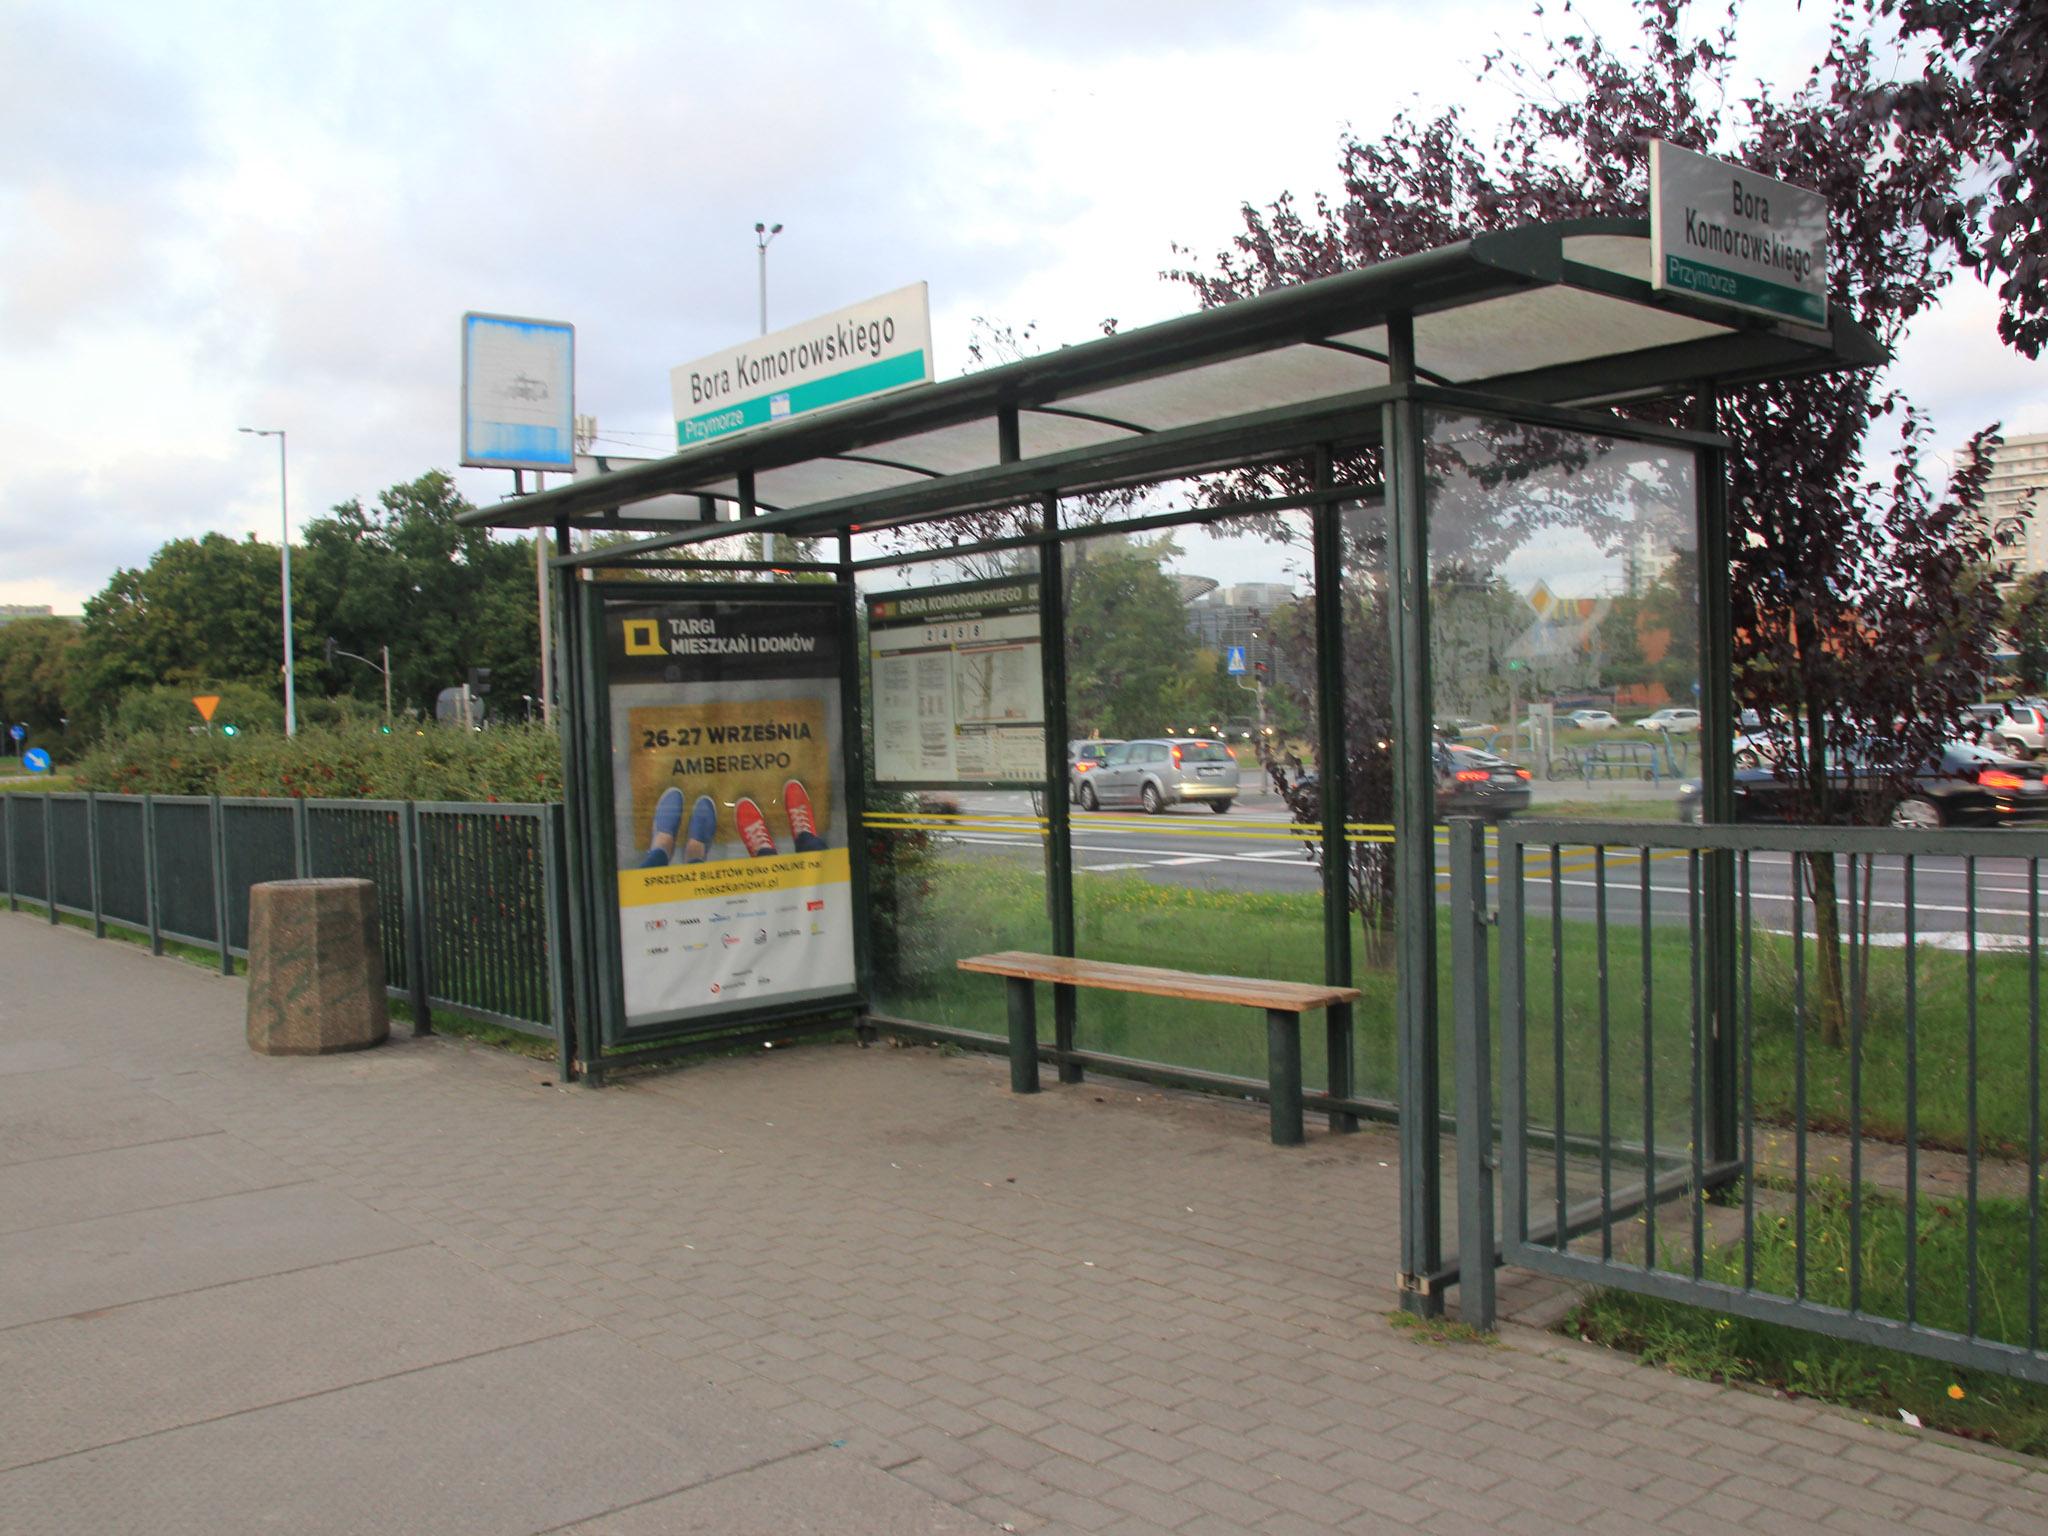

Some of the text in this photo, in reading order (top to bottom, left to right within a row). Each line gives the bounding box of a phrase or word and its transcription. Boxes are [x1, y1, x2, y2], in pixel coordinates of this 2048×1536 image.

[1732, 180, 1769, 224] Bora
[1685, 207, 1811, 282] Komorowskiego
[1669, 258, 1737, 294] Przymorze
[690, 313, 895, 404] Bora Komorowskiego
[685, 409, 744, 440] Przymorze
[900, 598, 927, 615] BORA
[928, 586, 1022, 611] KOMOROWSKIEGO
[668, 618, 715, 635] TARGI
[670, 633, 815, 655] MIESZKAŃ I DOMÓW
[643, 719, 812, 749] 26-27 WRZEŚNIA
[672, 752, 791, 776] AMBEREXPO
[644, 871, 697, 887] SPRZEDAŻ
[700, 867, 742, 880] BILETÓW
[771, 861, 805, 873] ONLINE
